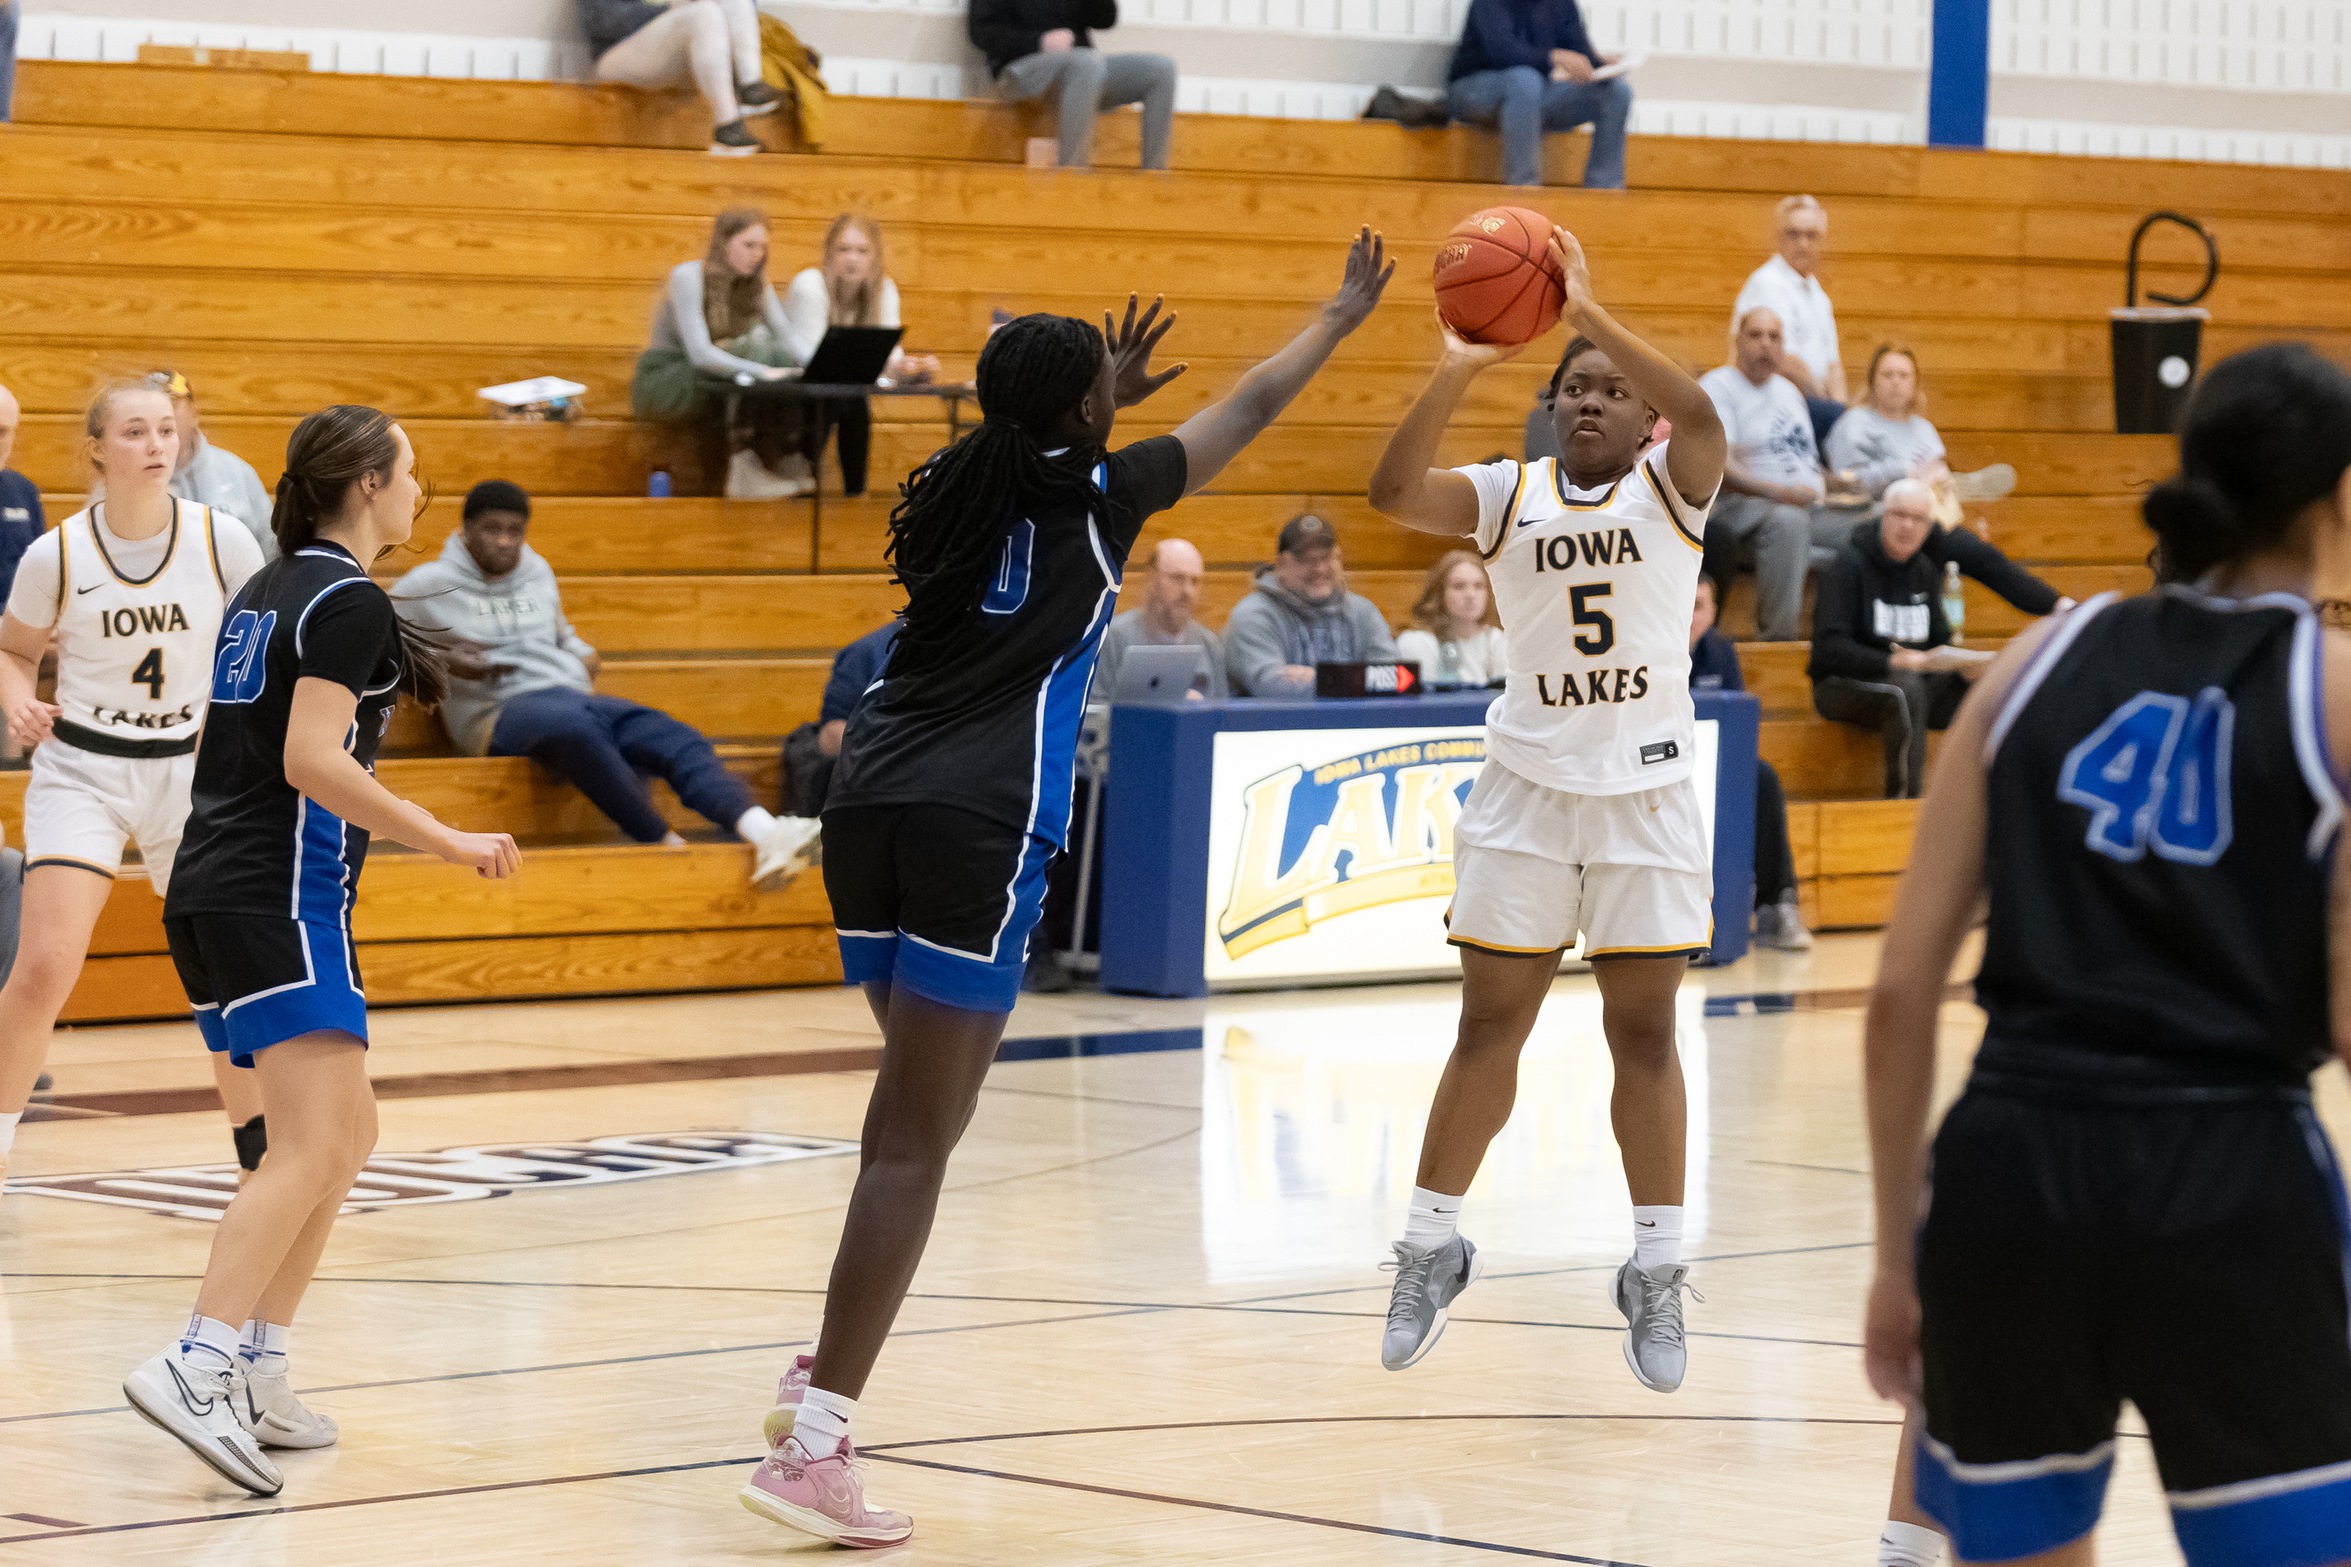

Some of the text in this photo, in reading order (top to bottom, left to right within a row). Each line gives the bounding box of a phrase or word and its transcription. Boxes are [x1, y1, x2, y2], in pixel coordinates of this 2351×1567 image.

[981, 517, 1035, 614] 0
[1535, 528, 1643, 573] IOWA
[101, 603, 190, 638] IOWA
[1567, 581, 1616, 658] 5
[130, 646, 166, 701] 4
[210, 610, 277, 703] 20
[1535, 665, 1648, 708] LAKES
[1314, 740, 1487, 786] IOWA LAKES COMMU
[1668, 745, 1675, 755] S
[2056, 685, 2237, 867] 40
[1219, 762, 1484, 934] LAK
